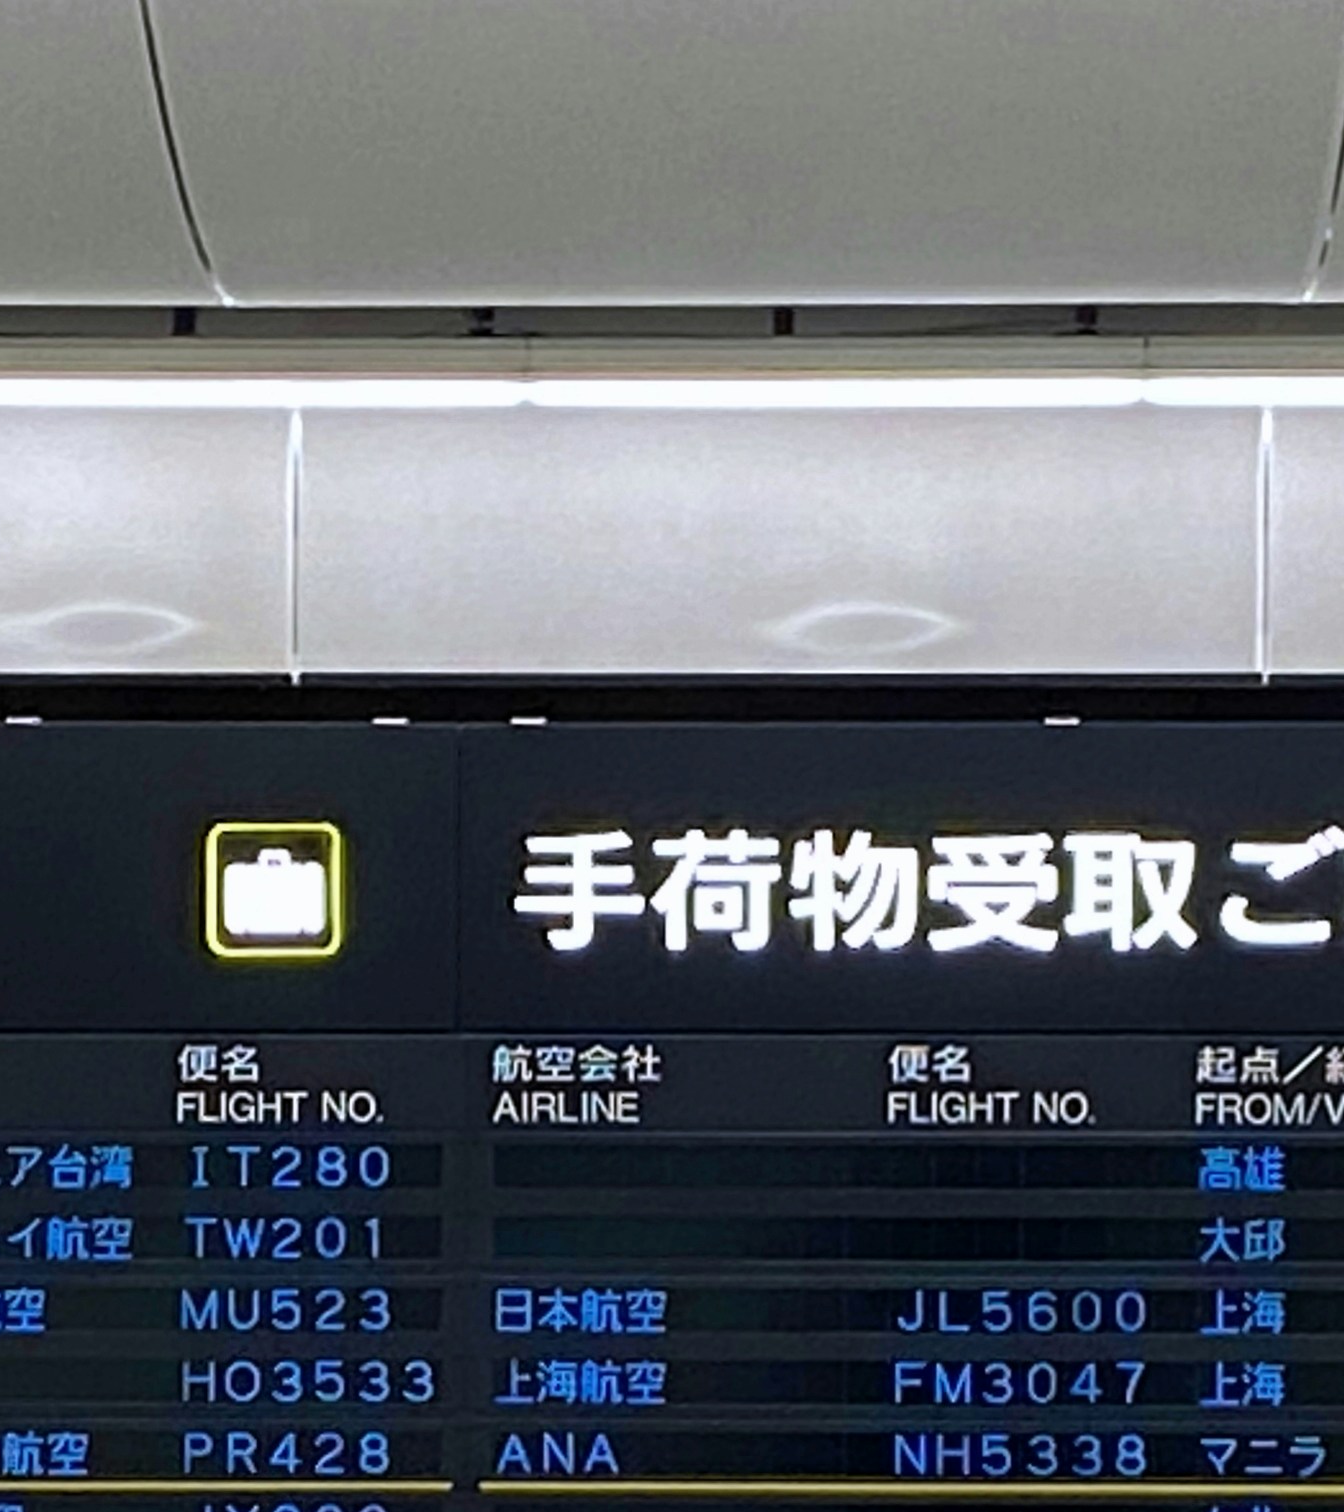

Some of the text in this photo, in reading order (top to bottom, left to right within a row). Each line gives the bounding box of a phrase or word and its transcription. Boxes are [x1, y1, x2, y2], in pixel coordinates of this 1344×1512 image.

[177, 1044, 260, 1083] 便名
[491, 1043, 662, 1083] 航空会社
[888, 1043, 971, 1084] 便名
[175, 1090, 385, 1124] FLIGHT NO.
[491, 1090, 641, 1124] AIRLINE
[886, 1090, 1095, 1125] FLIGHT NO.
[191, 1144, 390, 1189] IT280
[1198, 1144, 1286, 1193] 高雄
[184, 1216, 380, 1260] TW201
[1199, 1216, 1287, 1265] 大邱
[180, 1287, 391, 1332] MU523
[494, 1287, 668, 1334] 日本航空
[896, 1289, 1147, 1334] JL5600
[1199, 1287, 1286, 1337] 上海
[182, 1358, 435, 1404] HO3533
[494, 1358, 667, 1406] 上海航空
[893, 1360, 1146, 1405] FM3047
[1198, 1360, 1286, 1409] 上海
[183, 1430, 391, 1476] PR428
[494, 1432, 621, 1476] ANA
[892, 1432, 1148, 1478] NH5338
[1199, 1435, 1326, 1478] マニラ
